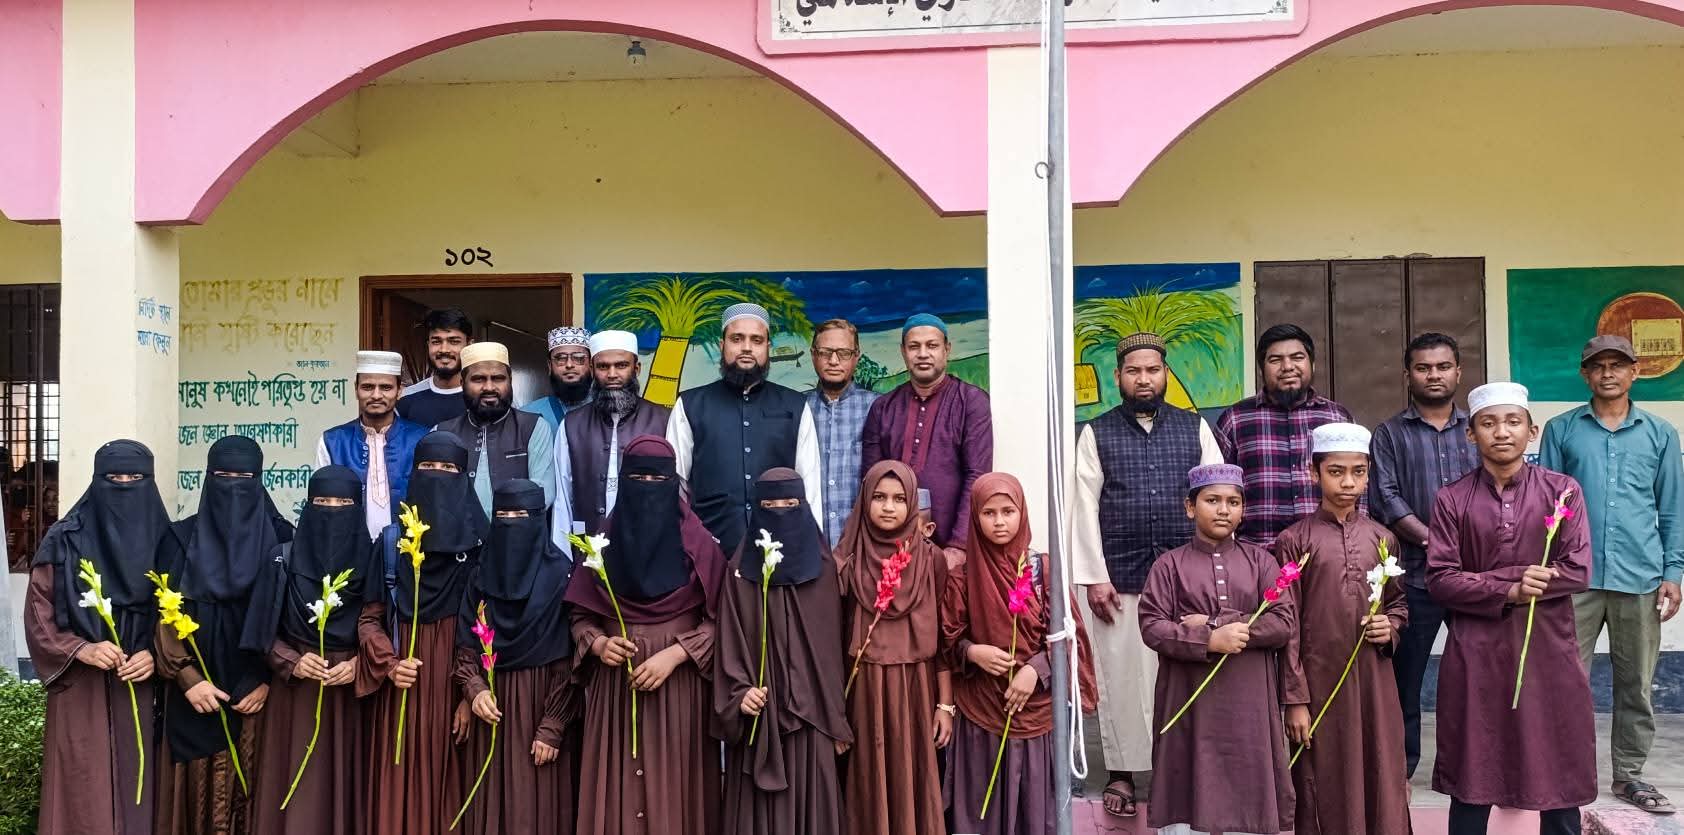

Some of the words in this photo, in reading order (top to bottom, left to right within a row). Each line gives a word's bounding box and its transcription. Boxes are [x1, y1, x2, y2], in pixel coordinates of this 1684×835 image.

[445, 247, 493, 267] ১০২
[332, 379, 348, 406] না
[178, 425, 199, 446] জন
[178, 470, 203, 490] জন
